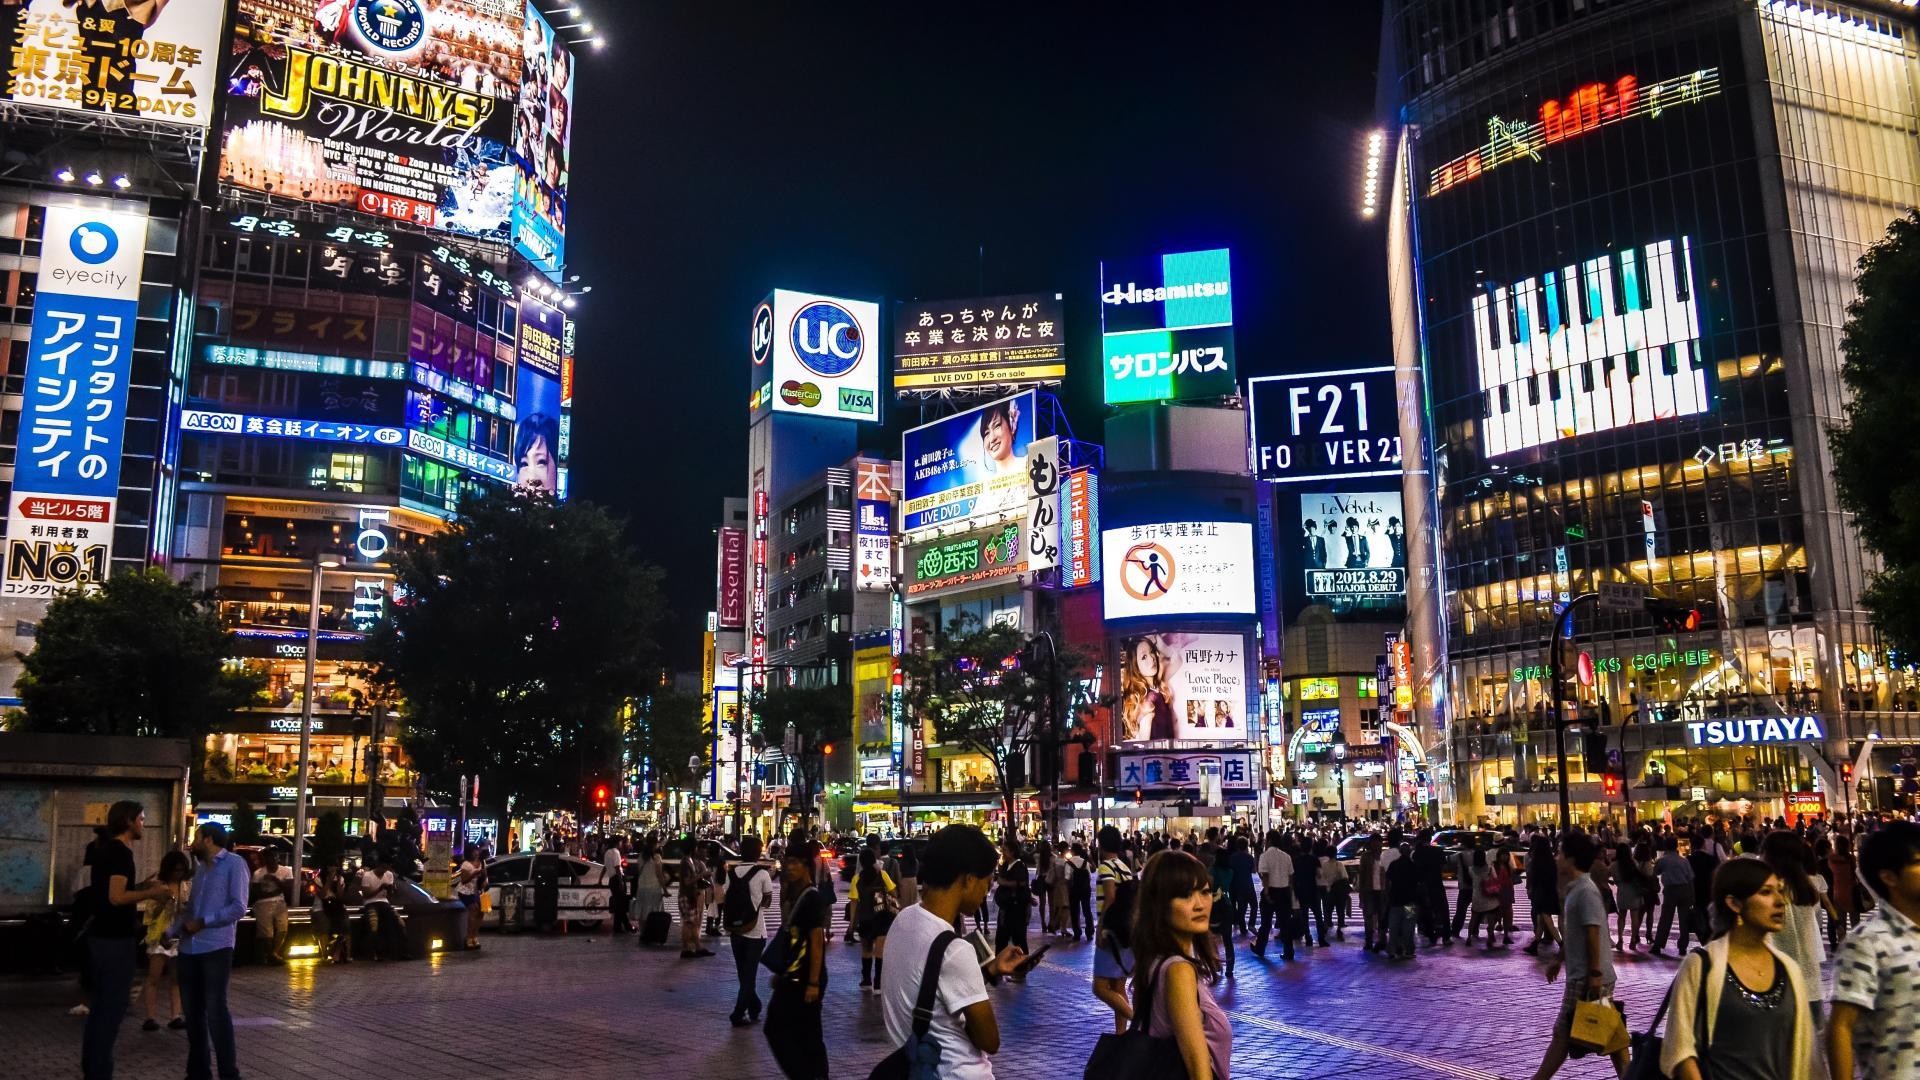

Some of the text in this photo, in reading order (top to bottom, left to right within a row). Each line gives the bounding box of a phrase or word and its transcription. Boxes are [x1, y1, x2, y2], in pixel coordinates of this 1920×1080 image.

[17, 8, 115, 34] タッキー&翼
[357, 6, 379, 42] WORLD
[383, 21, 421, 48] RECORDS
[14, 22, 202, 68] デビュー10周年
[8, 46, 197, 98] 東京ドーム
[263, 46, 494, 128] JOHNNYS'
[319, 103, 488, 150] World
[323, 148, 341, 160] NYC
[384, 162, 422, 179] JOHNNYS'
[423, 171, 437, 183] ALL
[437, 174, 463, 188] STARS
[364, 146, 387, 160] JUMP
[409, 156, 429, 170] Zone
[326, 170, 361, 186] OPENING
[362, 178, 372, 189] IN
[373, 179, 416, 197] NOVEMBER
[417, 190, 437, 203] 2012
[324, 249, 337, 258] 9F
[52, 268, 127, 290] eyecity
[1102, 282, 1228, 305] Hisamitsu
[919, 302, 1038, 327] あっちゃんが
[904, 321, 1054, 346] 卒業を決めた夜
[901, 356, 938, 367] 前田敦子
[1110, 347, 1228, 380] サロンパス
[933, 373, 952, 383] LIVE
[954, 373, 973, 381] DVD
[981, 371, 995, 379] 9.5
[1008, 370, 1026, 378] sale
[32, 311, 86, 478] アイシティ
[78, 315, 122, 480] コンタクトの
[781, 388, 820, 400] MasterCard
[842, 393, 872, 407] VISA
[1289, 381, 1368, 435] F21
[187, 413, 236, 430] AEON
[246, 418, 396, 442] 英会話イーオン 6F
[412, 433, 442, 454] AEON
[445, 443, 515, 478] 英会話イーオン
[30, 501, 103, 519] 当ビル5階
[261, 502, 337, 516] Natural Dining
[920, 509, 939, 525] LIVE
[940, 503, 961, 521] DVD
[1029, 453, 1058, 563] もんじゃ
[31, 525, 89, 539] 利用者数
[1071, 476, 1085, 579] 三千里薬品
[1131, 522, 1219, 541] 歩行喫煙禁止
[859, 537, 889, 549] 夜11時
[865, 550, 883, 560] まで
[7, 540, 107, 583] No.1
[873, 566, 890, 577] 地下
[944, 548, 979, 573] 西村
[722, 531, 740, 622] Essential
[1335, 571, 1397, 584] 2012.8.29
[1335, 583, 1398, 593] MAJOR DEBUT
[1186, 649, 1238, 664] 西野カナ
[1513, 649, 1710, 682] STAKS COFFEE
[271, 719, 323, 728] L'OCCINE
[1688, 716, 1822, 745] TSUTAYA
[1124, 758, 1244, 784] 大盛堂店
